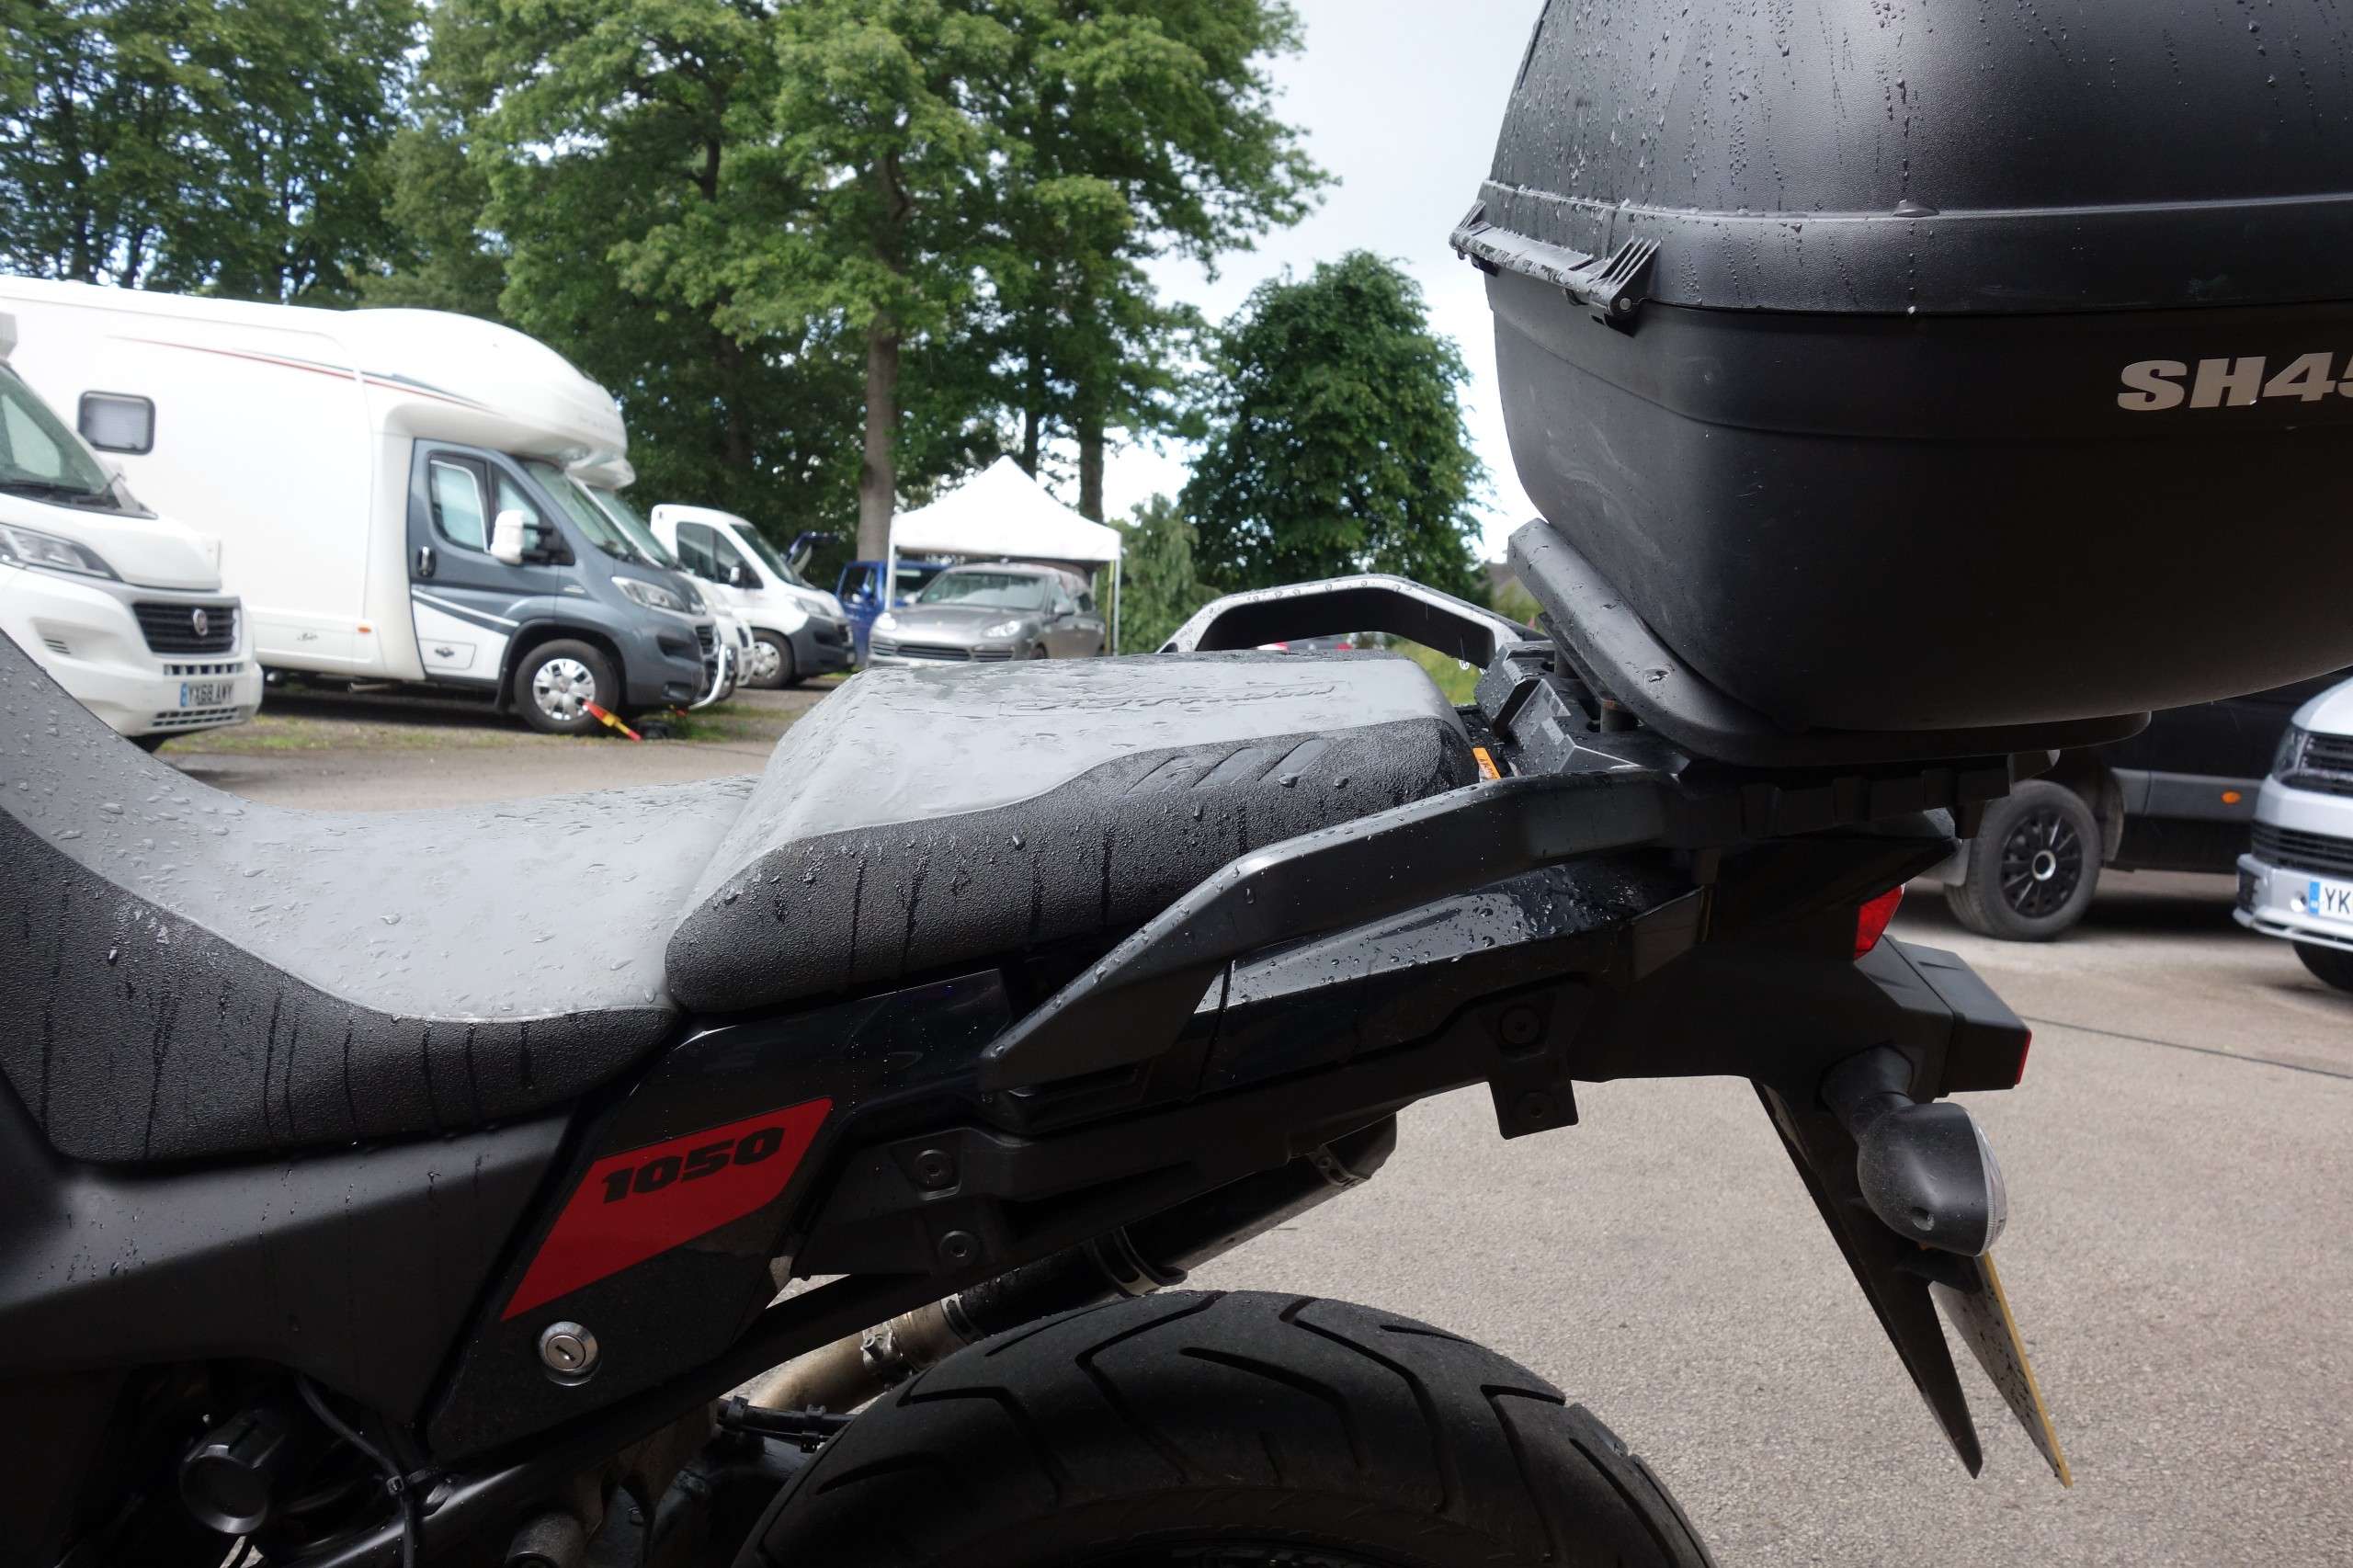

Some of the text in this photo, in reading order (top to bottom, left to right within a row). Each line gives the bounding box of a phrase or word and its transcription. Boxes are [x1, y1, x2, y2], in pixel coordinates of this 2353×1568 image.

[2117, 351, 2353, 411] SH4
[2325, 887, 2351, 915] YK
[601, 1127, 785, 1204] 1050
